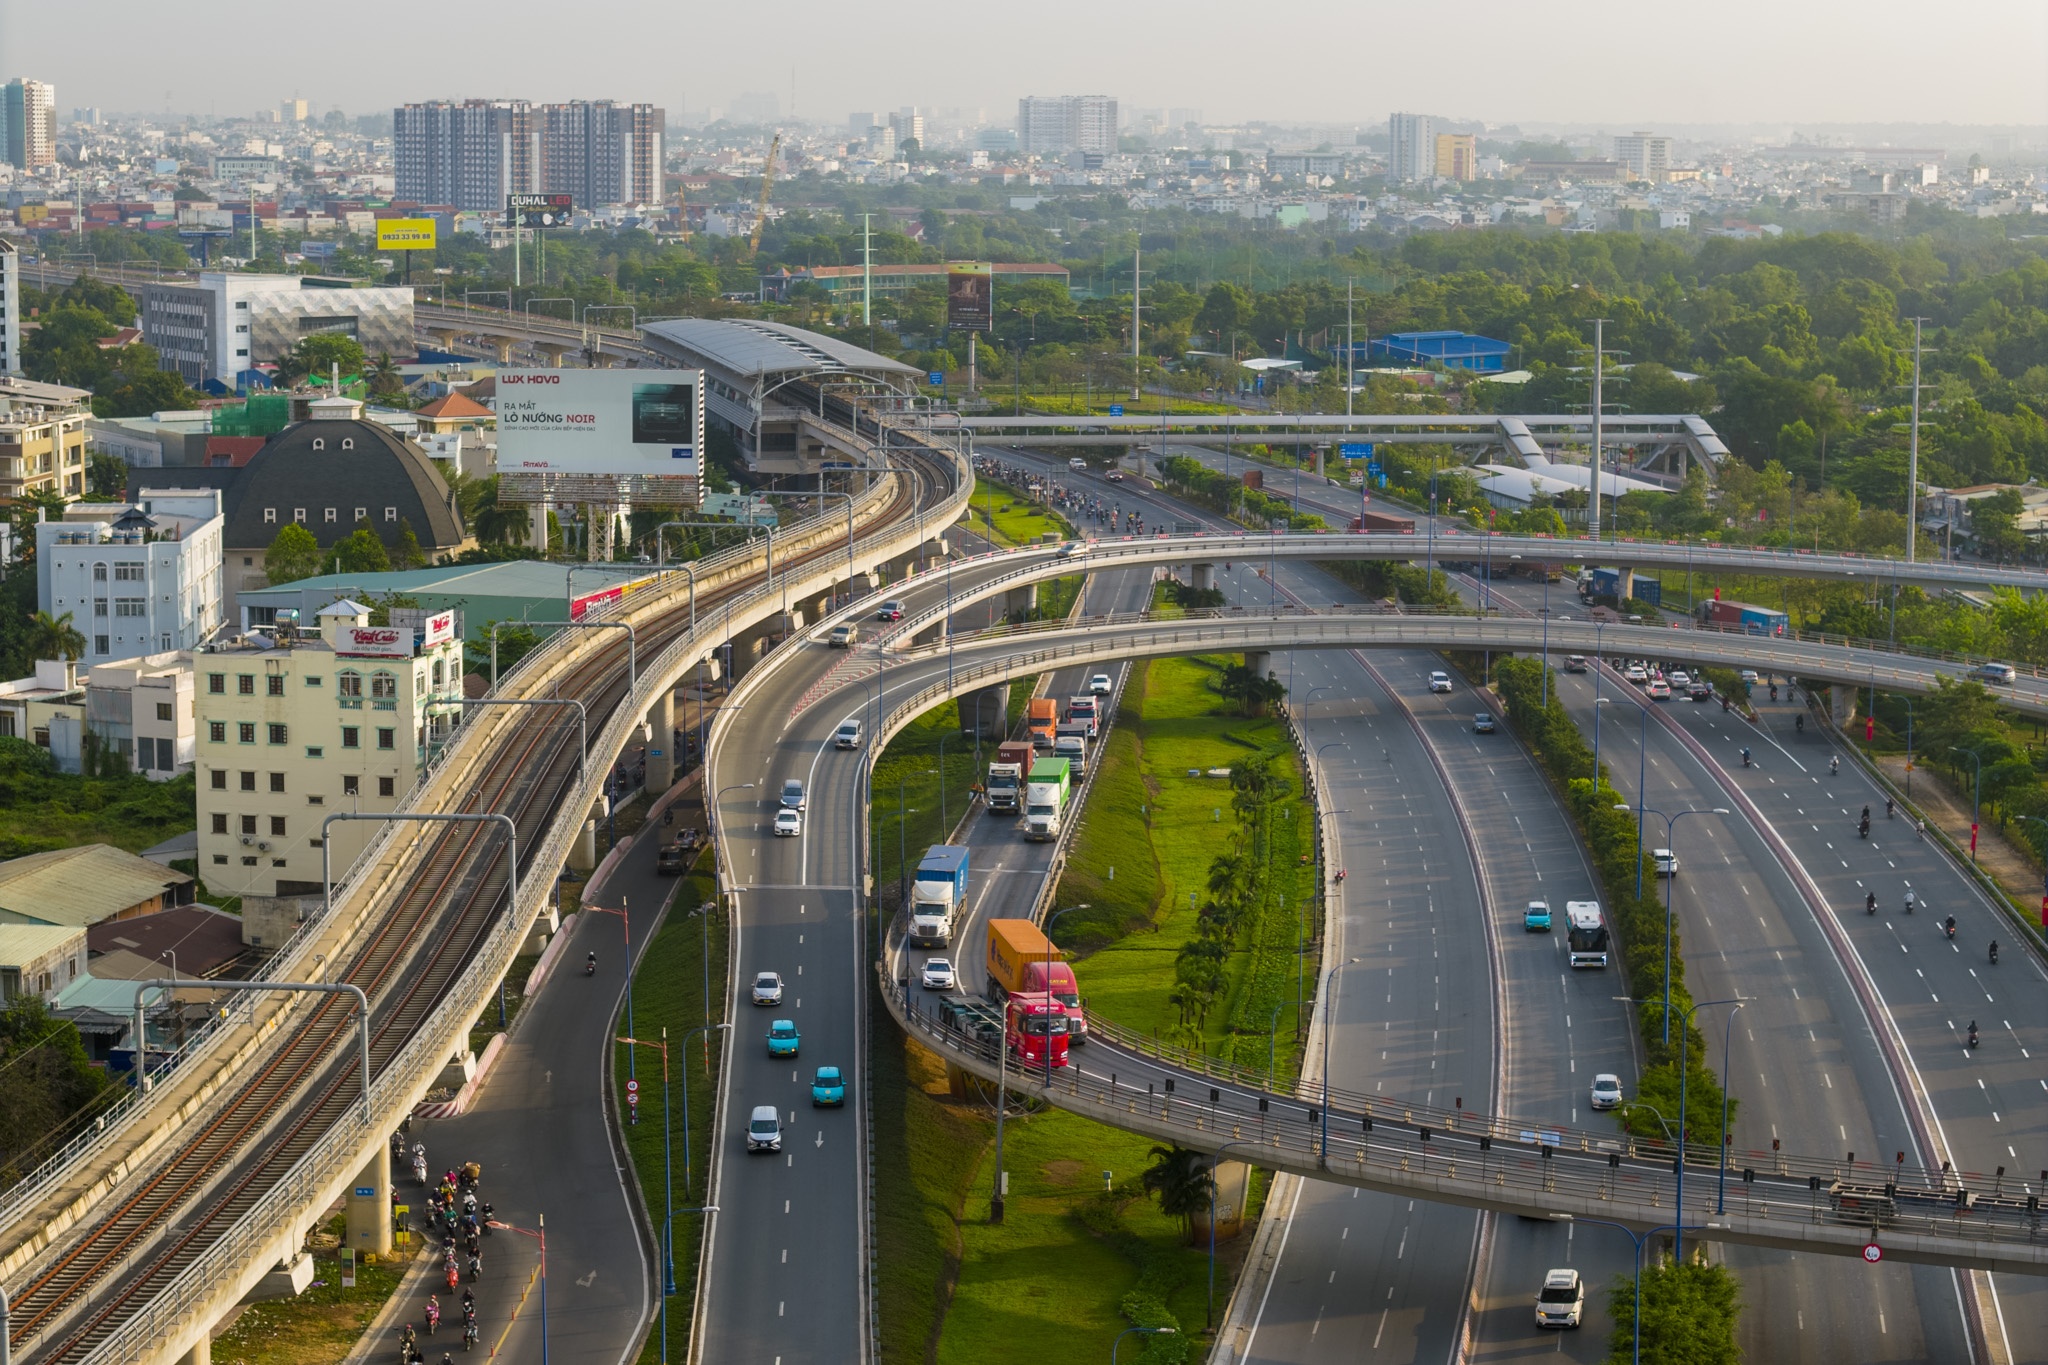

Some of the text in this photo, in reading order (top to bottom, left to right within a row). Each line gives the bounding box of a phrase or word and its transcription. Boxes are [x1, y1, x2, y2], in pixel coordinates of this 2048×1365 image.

[511, 196, 571, 205] DUHAL LED
[502, 375, 560, 384] LUX HOVO
[504, 400, 537, 410] RA MẮT
[504, 412, 596, 424] LÒ NƯỚNG NOIR
